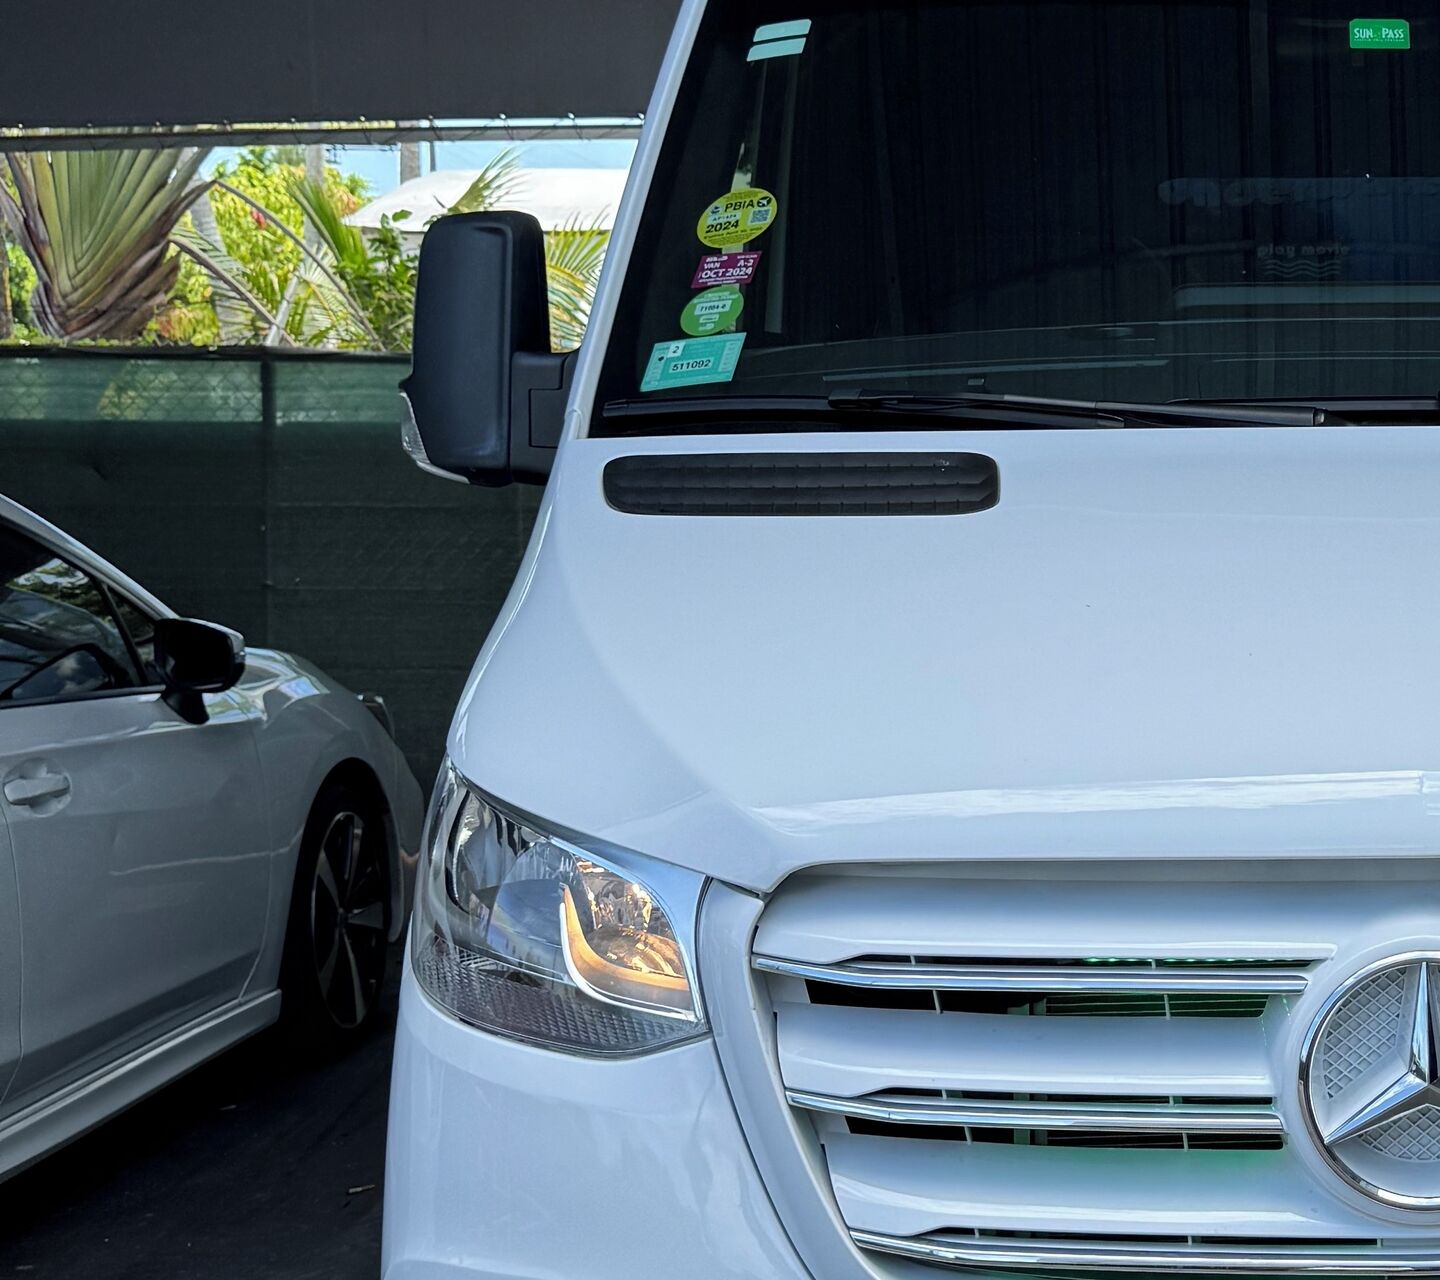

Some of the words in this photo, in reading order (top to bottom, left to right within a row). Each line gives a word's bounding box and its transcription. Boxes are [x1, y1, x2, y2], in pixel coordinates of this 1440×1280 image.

[1353, 27, 1374, 39] SUN
[1381, 27, 1405, 39] PASS
[724, 199, 755, 212] PBIA
[705, 220, 740, 234] 2024
[1256, 243, 1296, 259] play
[703, 261, 721, 269] VAN
[701, 268, 726, 278] OCT
[725, 267, 753, 276] 2024
[671, 345, 680, 354] 2
[671, 359, 711, 372] 511092
